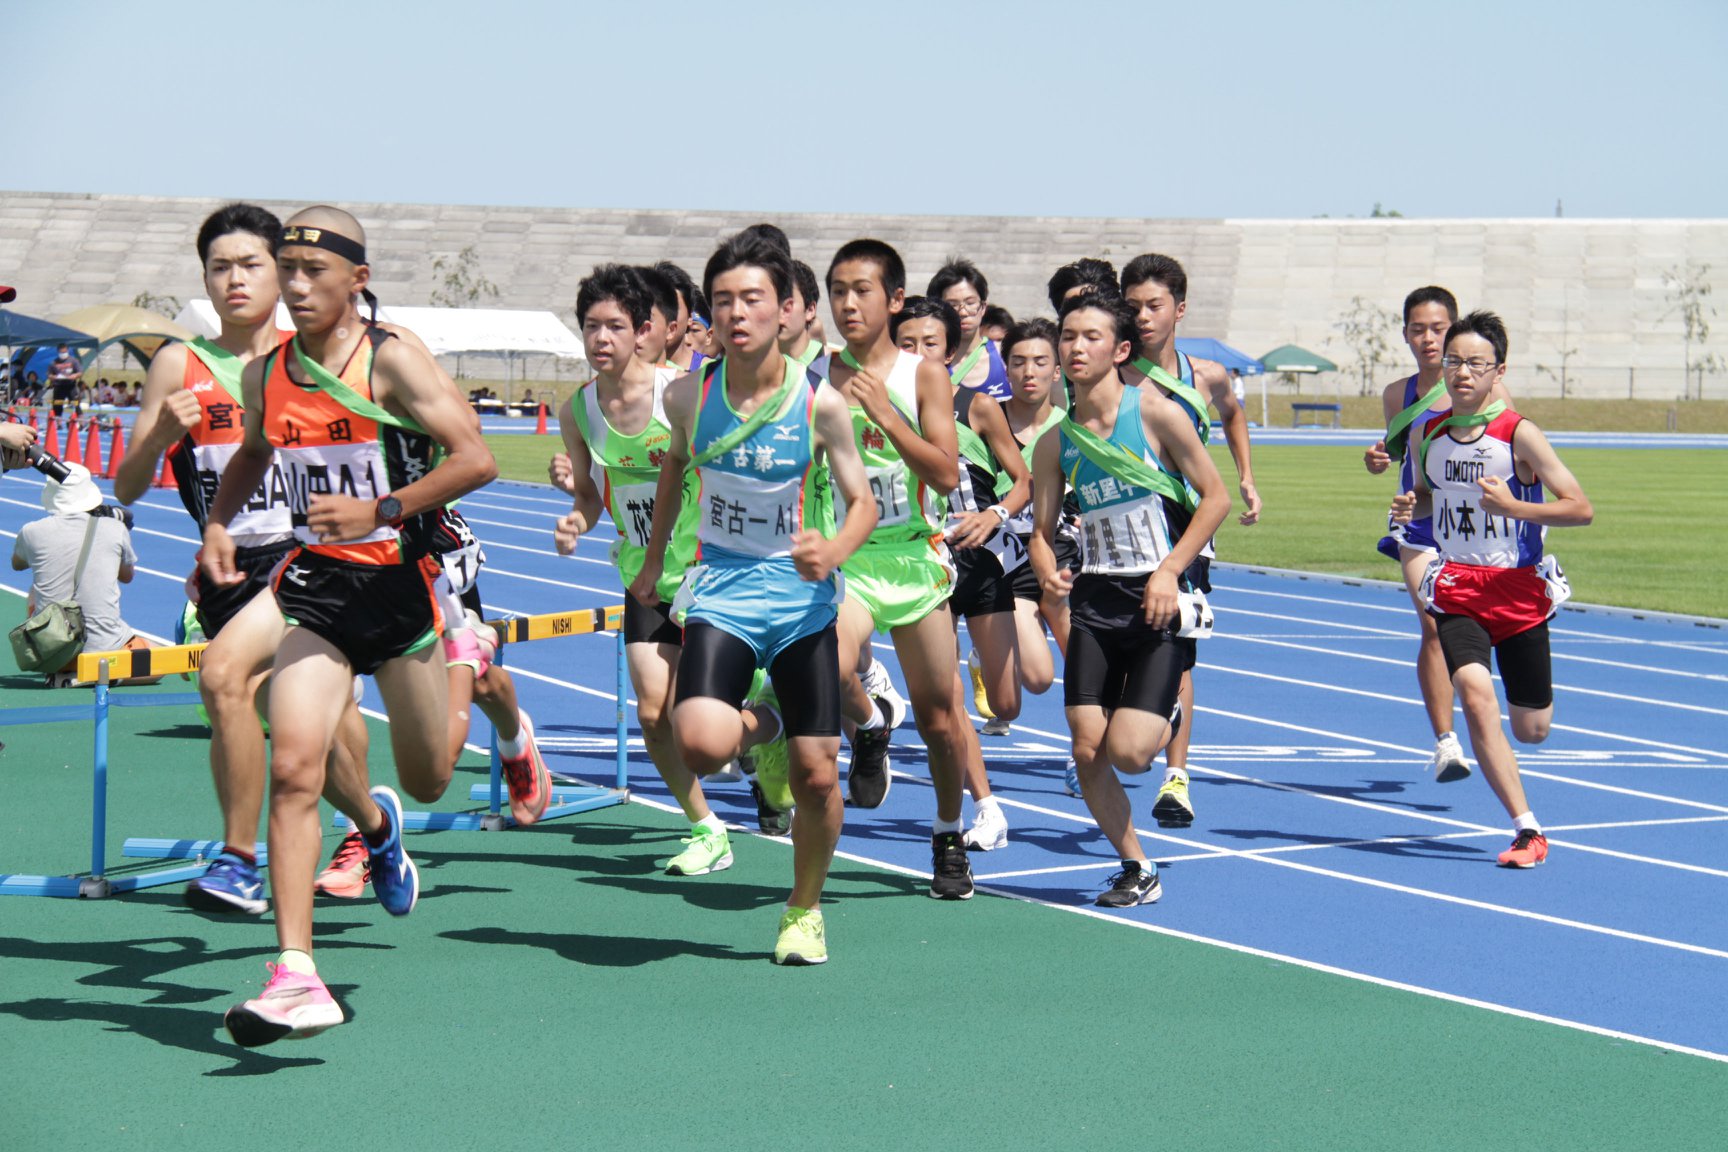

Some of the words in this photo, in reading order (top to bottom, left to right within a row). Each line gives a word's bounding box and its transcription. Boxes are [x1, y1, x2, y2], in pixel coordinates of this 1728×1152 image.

[206, 402, 244, 431] 宮
[282, 418, 351, 447] 山田
[1445, 459, 1484, 484] OMOTO
[552, 617, 572, 635] NISHI
